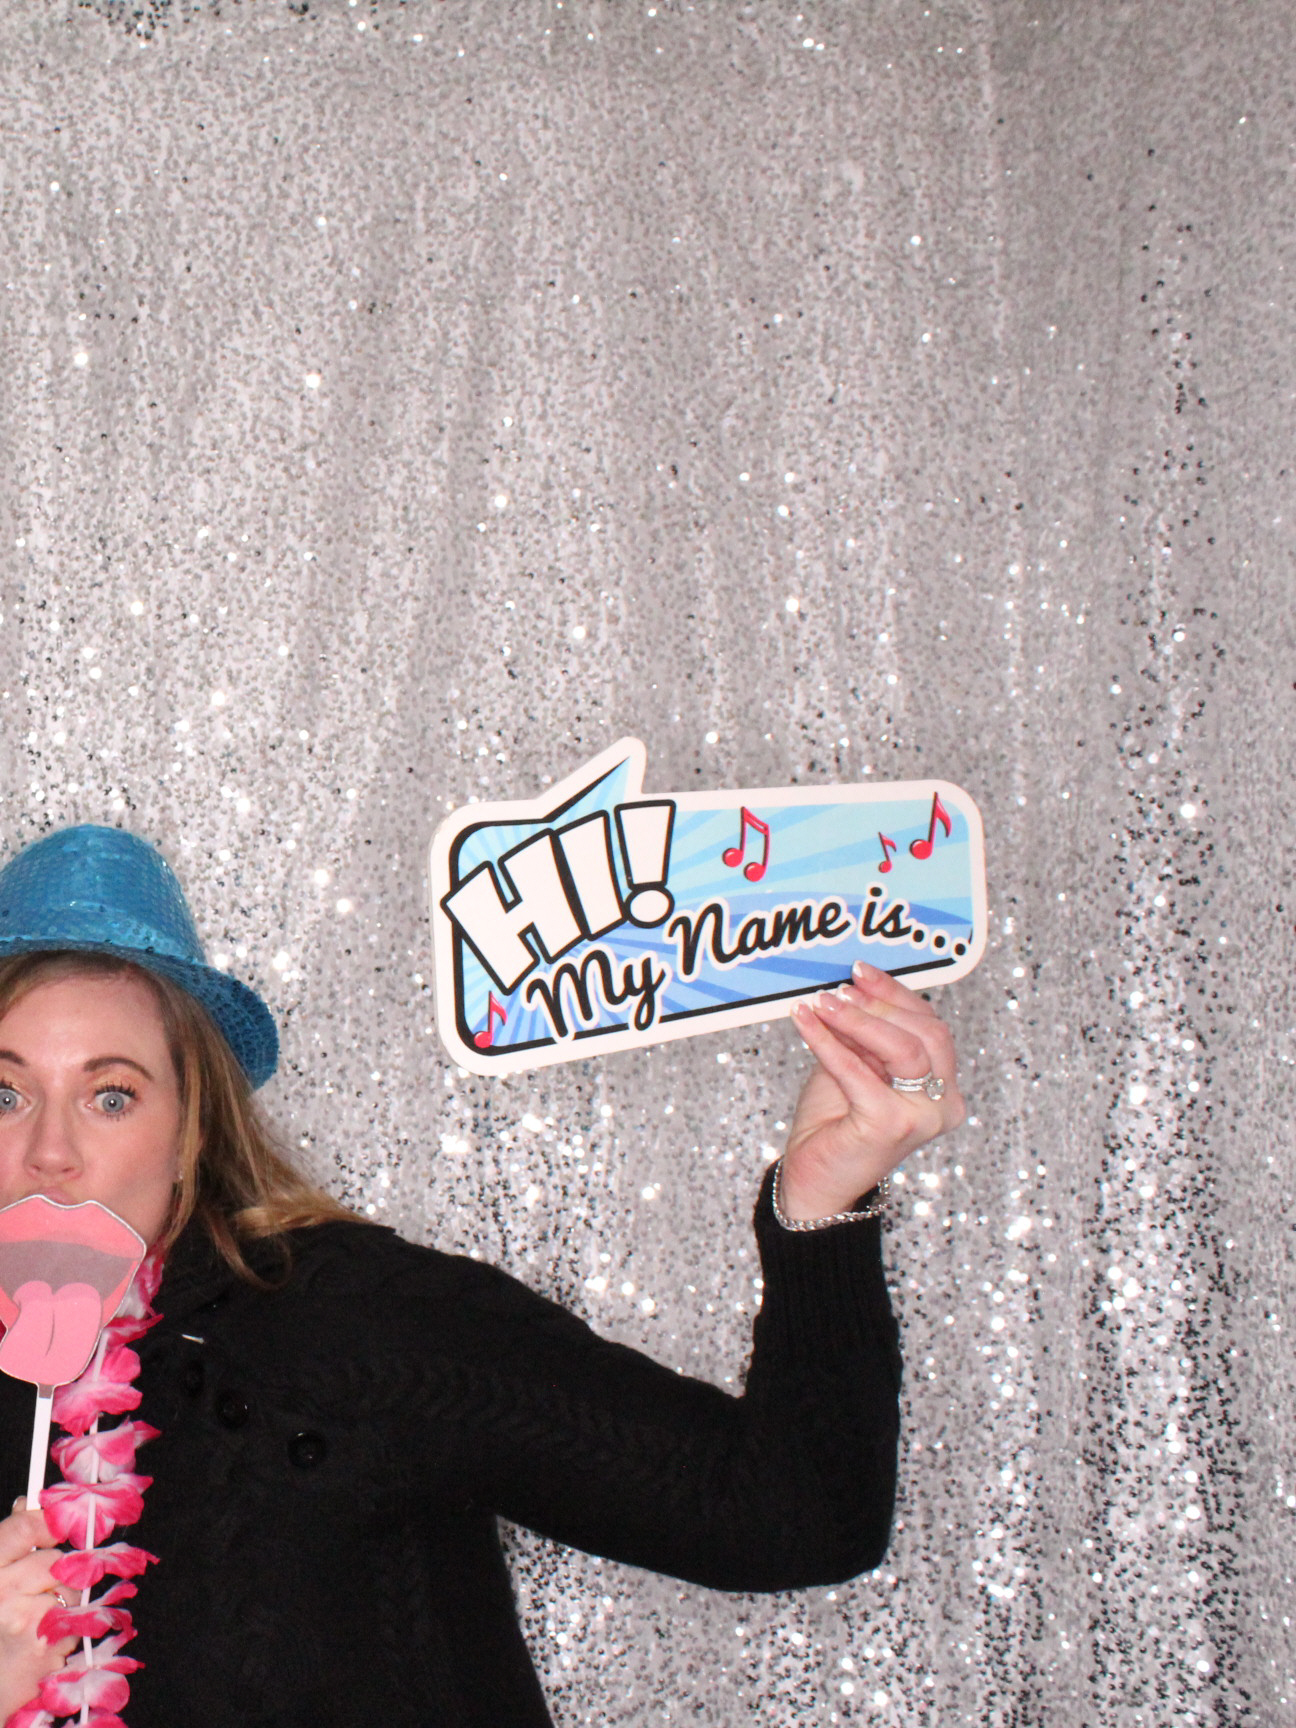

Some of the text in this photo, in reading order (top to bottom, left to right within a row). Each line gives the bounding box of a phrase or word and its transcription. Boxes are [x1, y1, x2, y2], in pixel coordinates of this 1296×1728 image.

[442, 801, 676, 995] HI!
[527, 950, 665, 1037] My
[670, 904, 850, 975] Name
